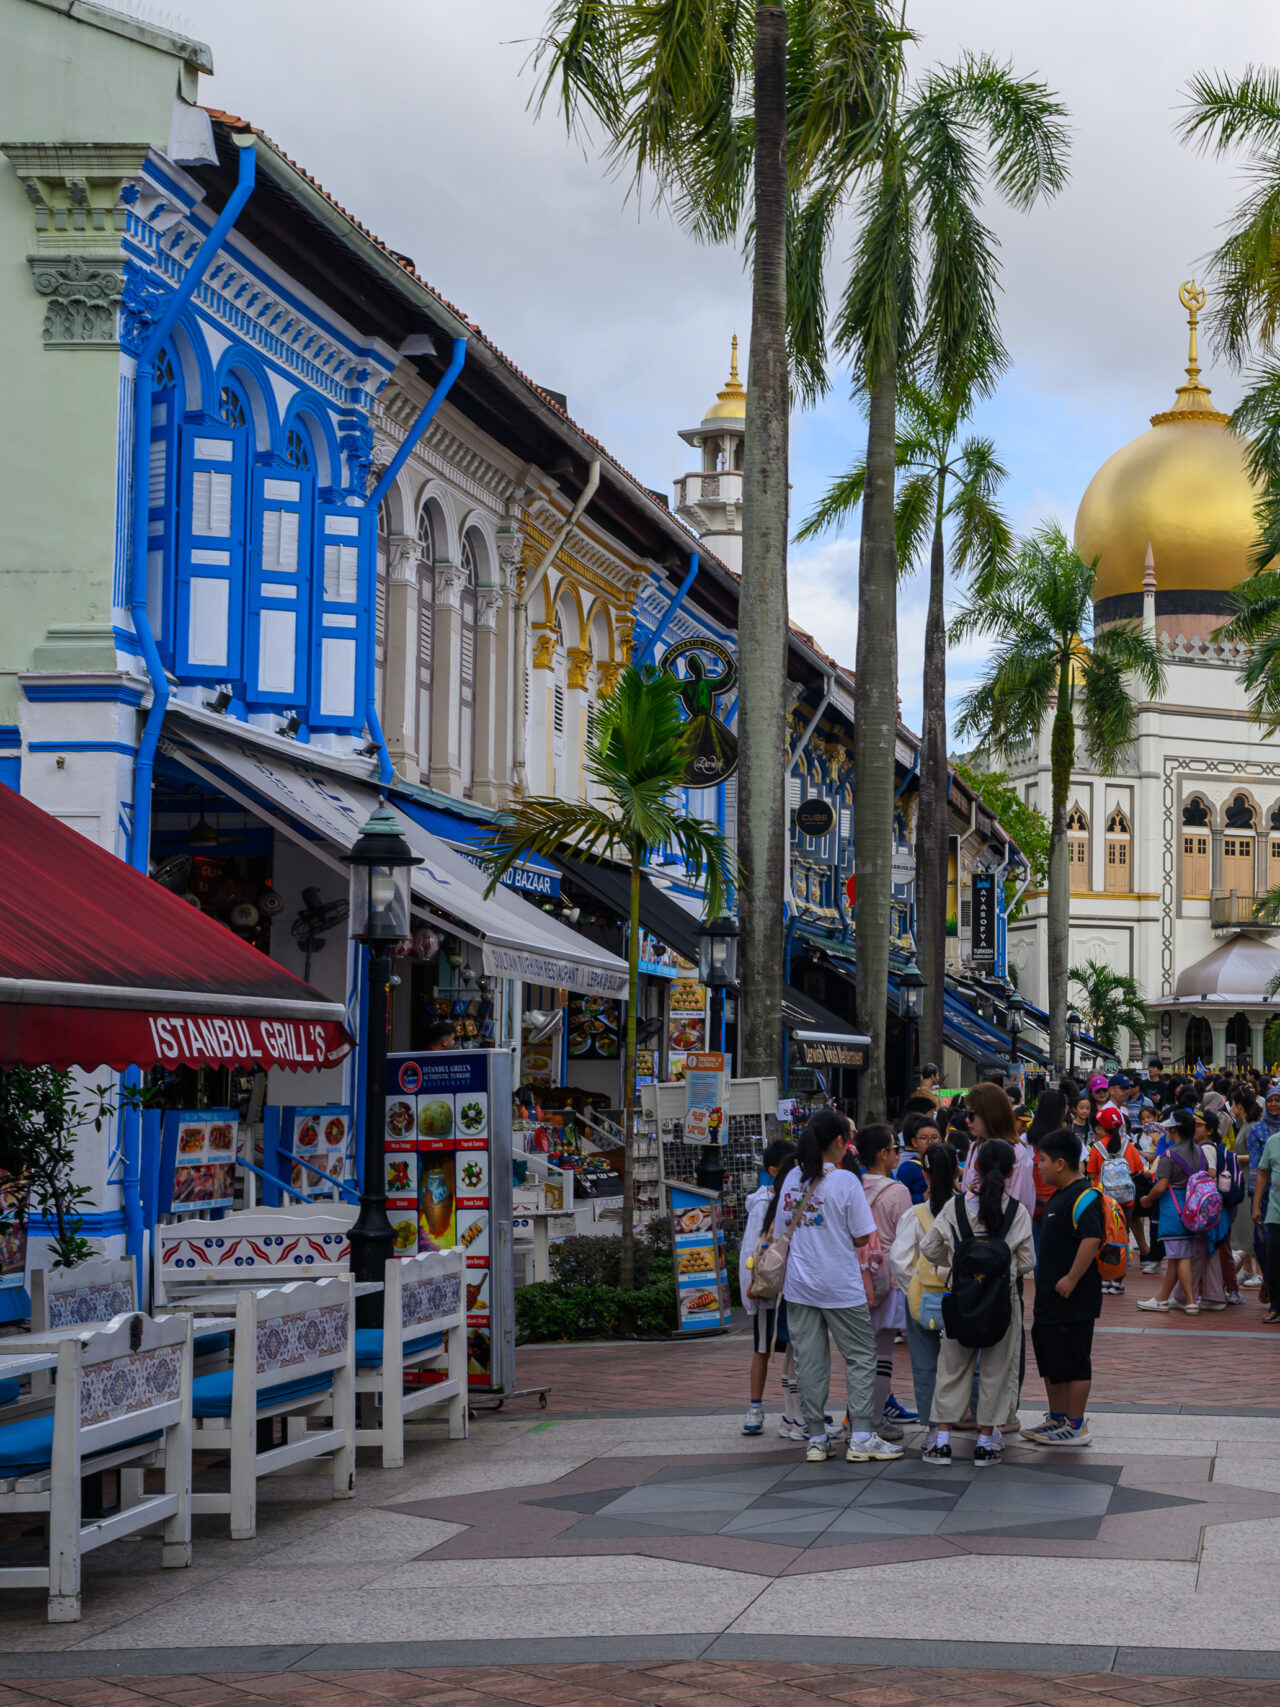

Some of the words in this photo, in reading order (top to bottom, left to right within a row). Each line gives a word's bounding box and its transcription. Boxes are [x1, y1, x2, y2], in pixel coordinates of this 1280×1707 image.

[514, 869, 552, 894] BAZAAR
[979, 889, 988, 947] AYASOFYA
[148, 1016, 263, 1058] ISTANBUL
[260, 1020, 327, 1063] GRILL'S
[422, 1065, 448, 1073] ISTANBUL
[422, 1079, 471, 1087] RESTAURANT
